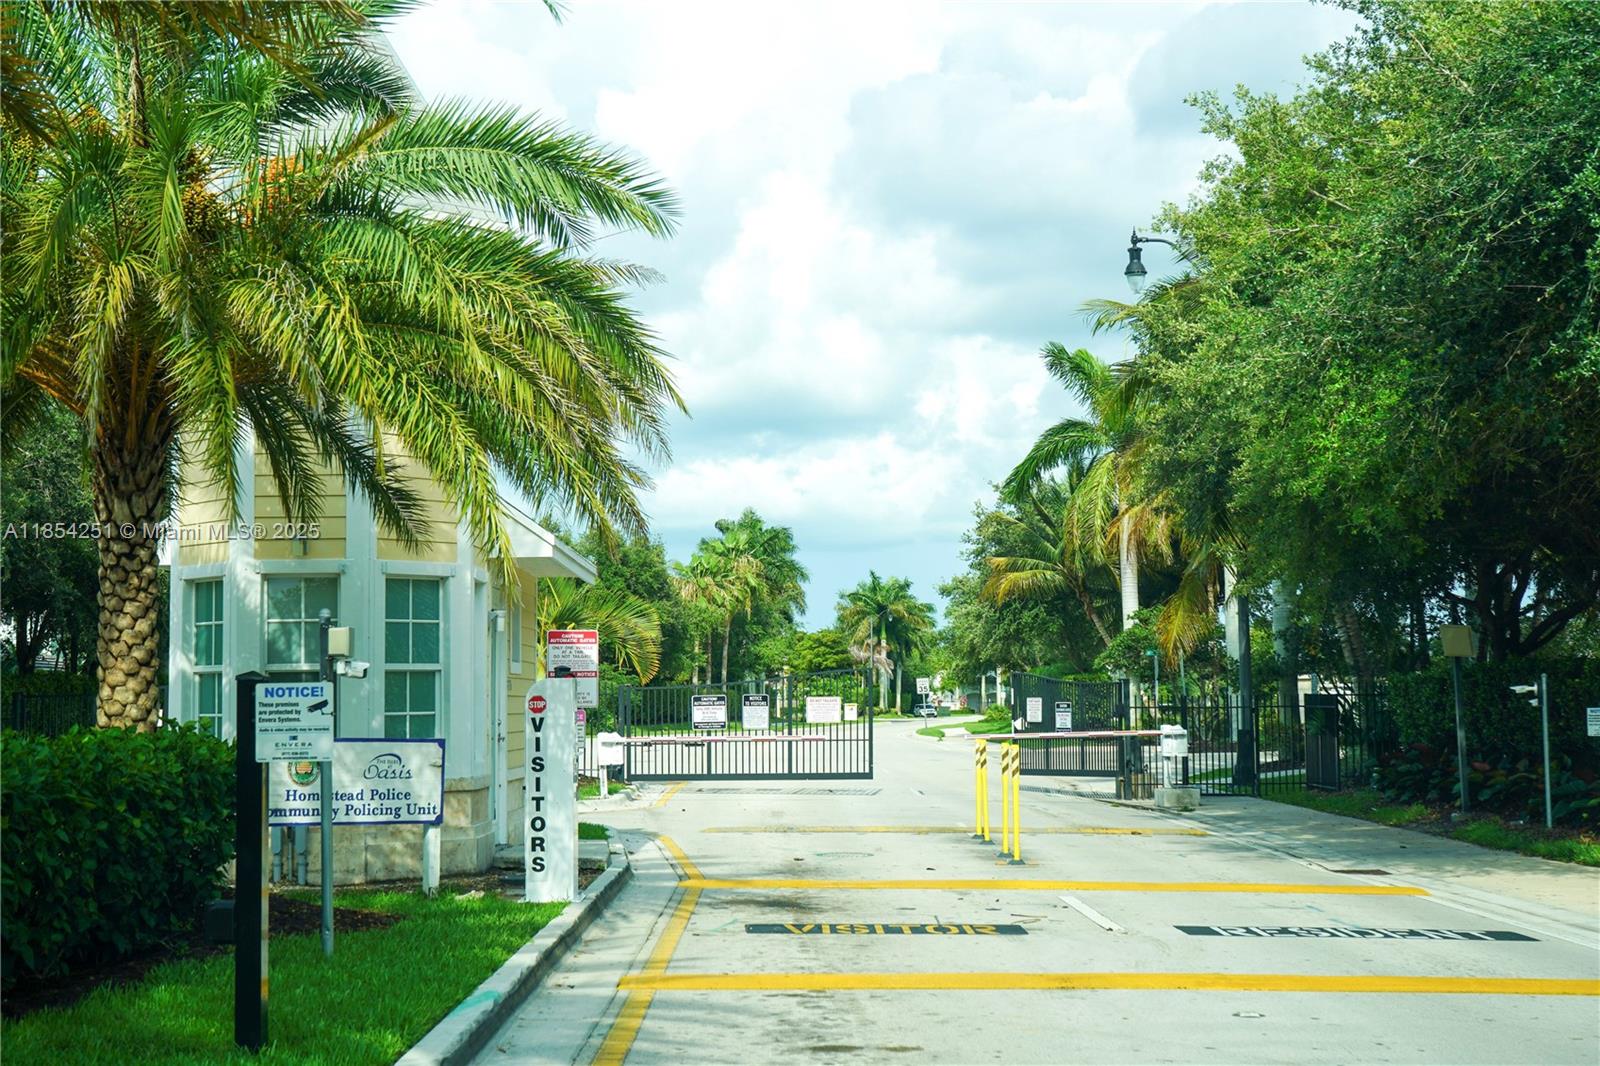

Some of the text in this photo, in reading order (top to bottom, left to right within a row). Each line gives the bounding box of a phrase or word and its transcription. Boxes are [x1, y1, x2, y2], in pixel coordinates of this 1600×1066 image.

[264, 686, 324, 698] NOTICE!
[528, 700, 546, 709] STOP
[363, 764, 413, 780] Oasis
[284, 788, 411, 802] Homtead Police
[530, 716, 546, 873] VISITORS
[344, 803, 402, 819] Policing
[406, 802, 438, 815] Unit
[784, 923, 1000, 935] VISITOR
[1208, 926, 1498, 941] RESIDENT
